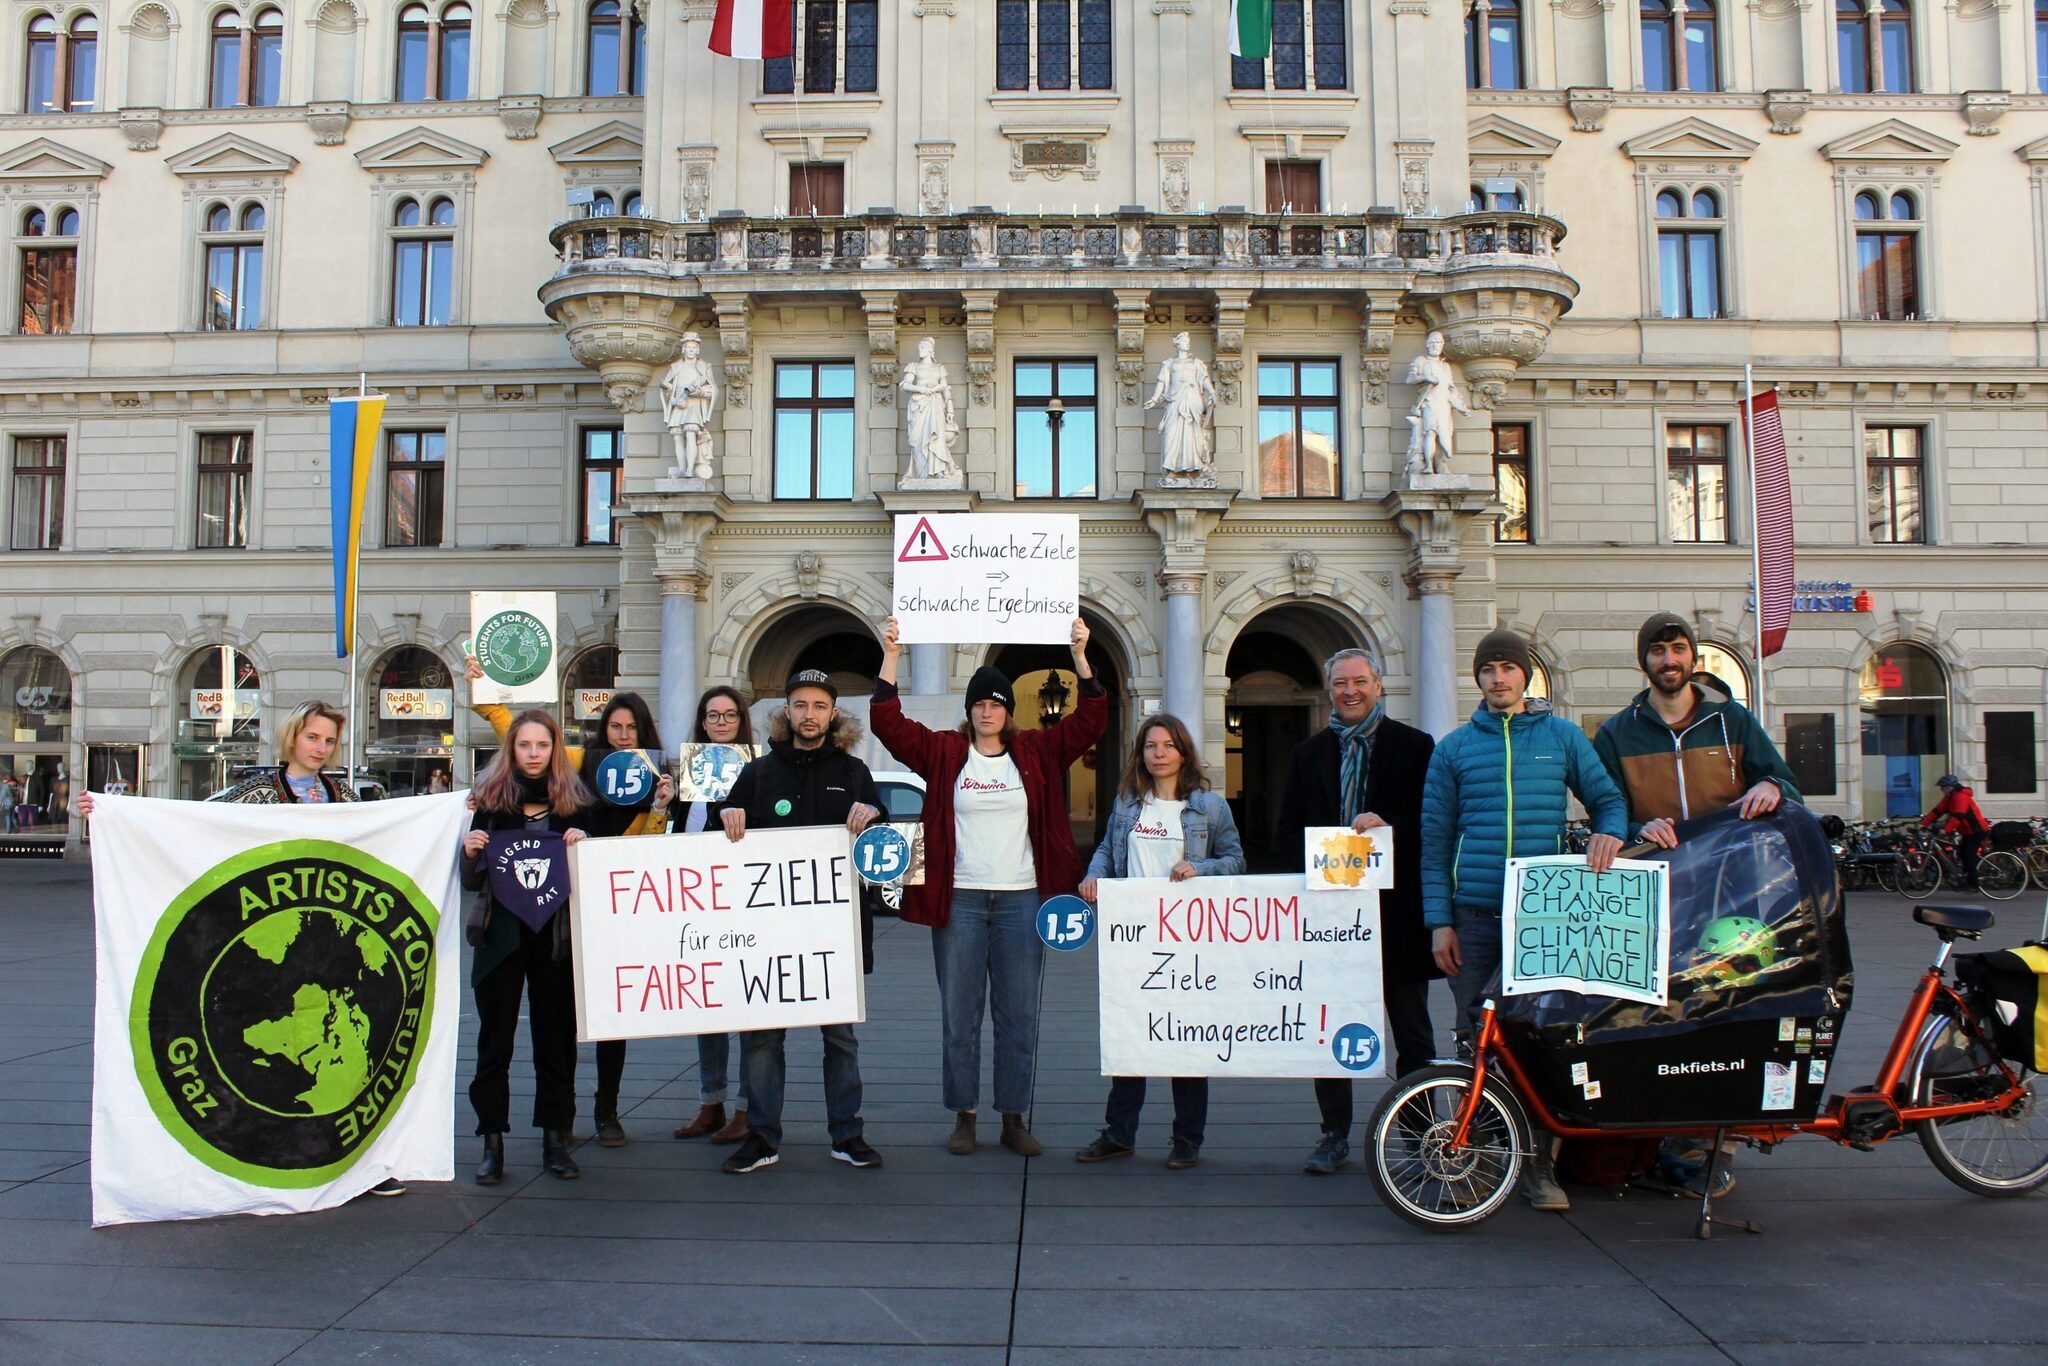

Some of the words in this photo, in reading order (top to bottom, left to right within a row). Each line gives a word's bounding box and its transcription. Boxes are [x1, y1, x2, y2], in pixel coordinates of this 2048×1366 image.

[950, 534, 1026, 559] schwache
[1029, 532, 1077, 560] Ziele
[898, 586, 979, 613] schwache
[987, 587, 1075, 624] Ergebnisse
[479, 619, 501, 667] STUDENTS
[501, 614, 522, 624] FOR
[523, 616, 549, 648] FUTURE
[514, 671, 535, 682] Graz
[197, 692, 214, 702] Red
[387, 692, 405, 702] Red
[406, 692, 424, 702] Bull
[582, 692, 600, 702] Red
[606, 767, 643, 798] 1,5
[496, 839, 541, 873] JUGEND
[863, 843, 900, 875] 1,5
[238, 867, 396, 920] ARTISTS
[536, 886, 559, 906] RAT
[609, 864, 731, 914] FAIRE
[743, 856, 850, 909] ZIELE
[1522, 868, 1641, 897] SYSTEM
[1521, 891, 1642, 918] CHANGE
[1568, 910, 1604, 923] NOT
[679, 922, 710, 959] für
[718, 929, 757, 950] eine
[1047, 913, 1084, 944] 1,5
[1110, 922, 1147, 942] nur
[388, 915, 430, 994] FOR
[1519, 947, 1642, 985] CHANGE
[615, 961, 723, 1013] FAIRE
[739, 951, 836, 1005] WELT
[1140, 951, 1217, 991] Ziele
[1252, 960, 1303, 991] sind
[1340, 1037, 1371, 1064] 1,5
[167, 1035, 219, 1119] Graz
[335, 1007, 420, 1148] FUTURE
[1657, 1058, 1745, 1076] Bakfiets.nl
